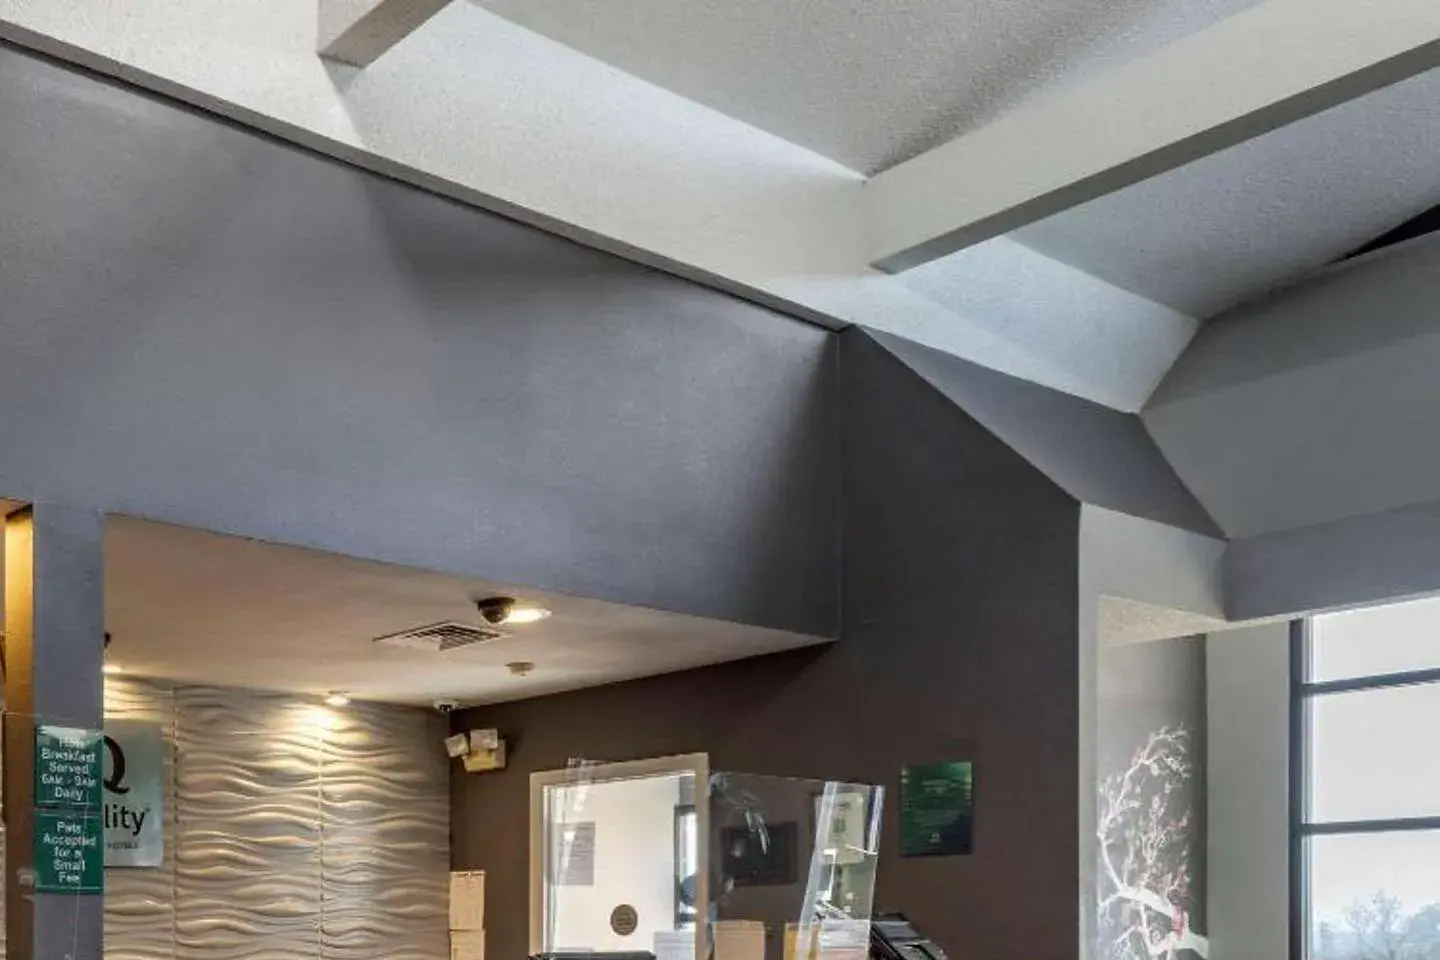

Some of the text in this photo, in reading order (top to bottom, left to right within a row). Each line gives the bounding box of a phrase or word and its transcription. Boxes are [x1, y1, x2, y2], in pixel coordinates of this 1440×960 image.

[41, 747, 96, 763] Breakfast
[49, 761, 89, 774] Served
[55, 786, 83, 801] Daily
[104, 803, 145, 836] lity
[56, 820, 82, 834] Pets
[43, 832, 96, 847] Accepted
[53, 846, 71, 857] for
[52, 858, 86, 872] Small
[59, 871, 81, 883] Fee
